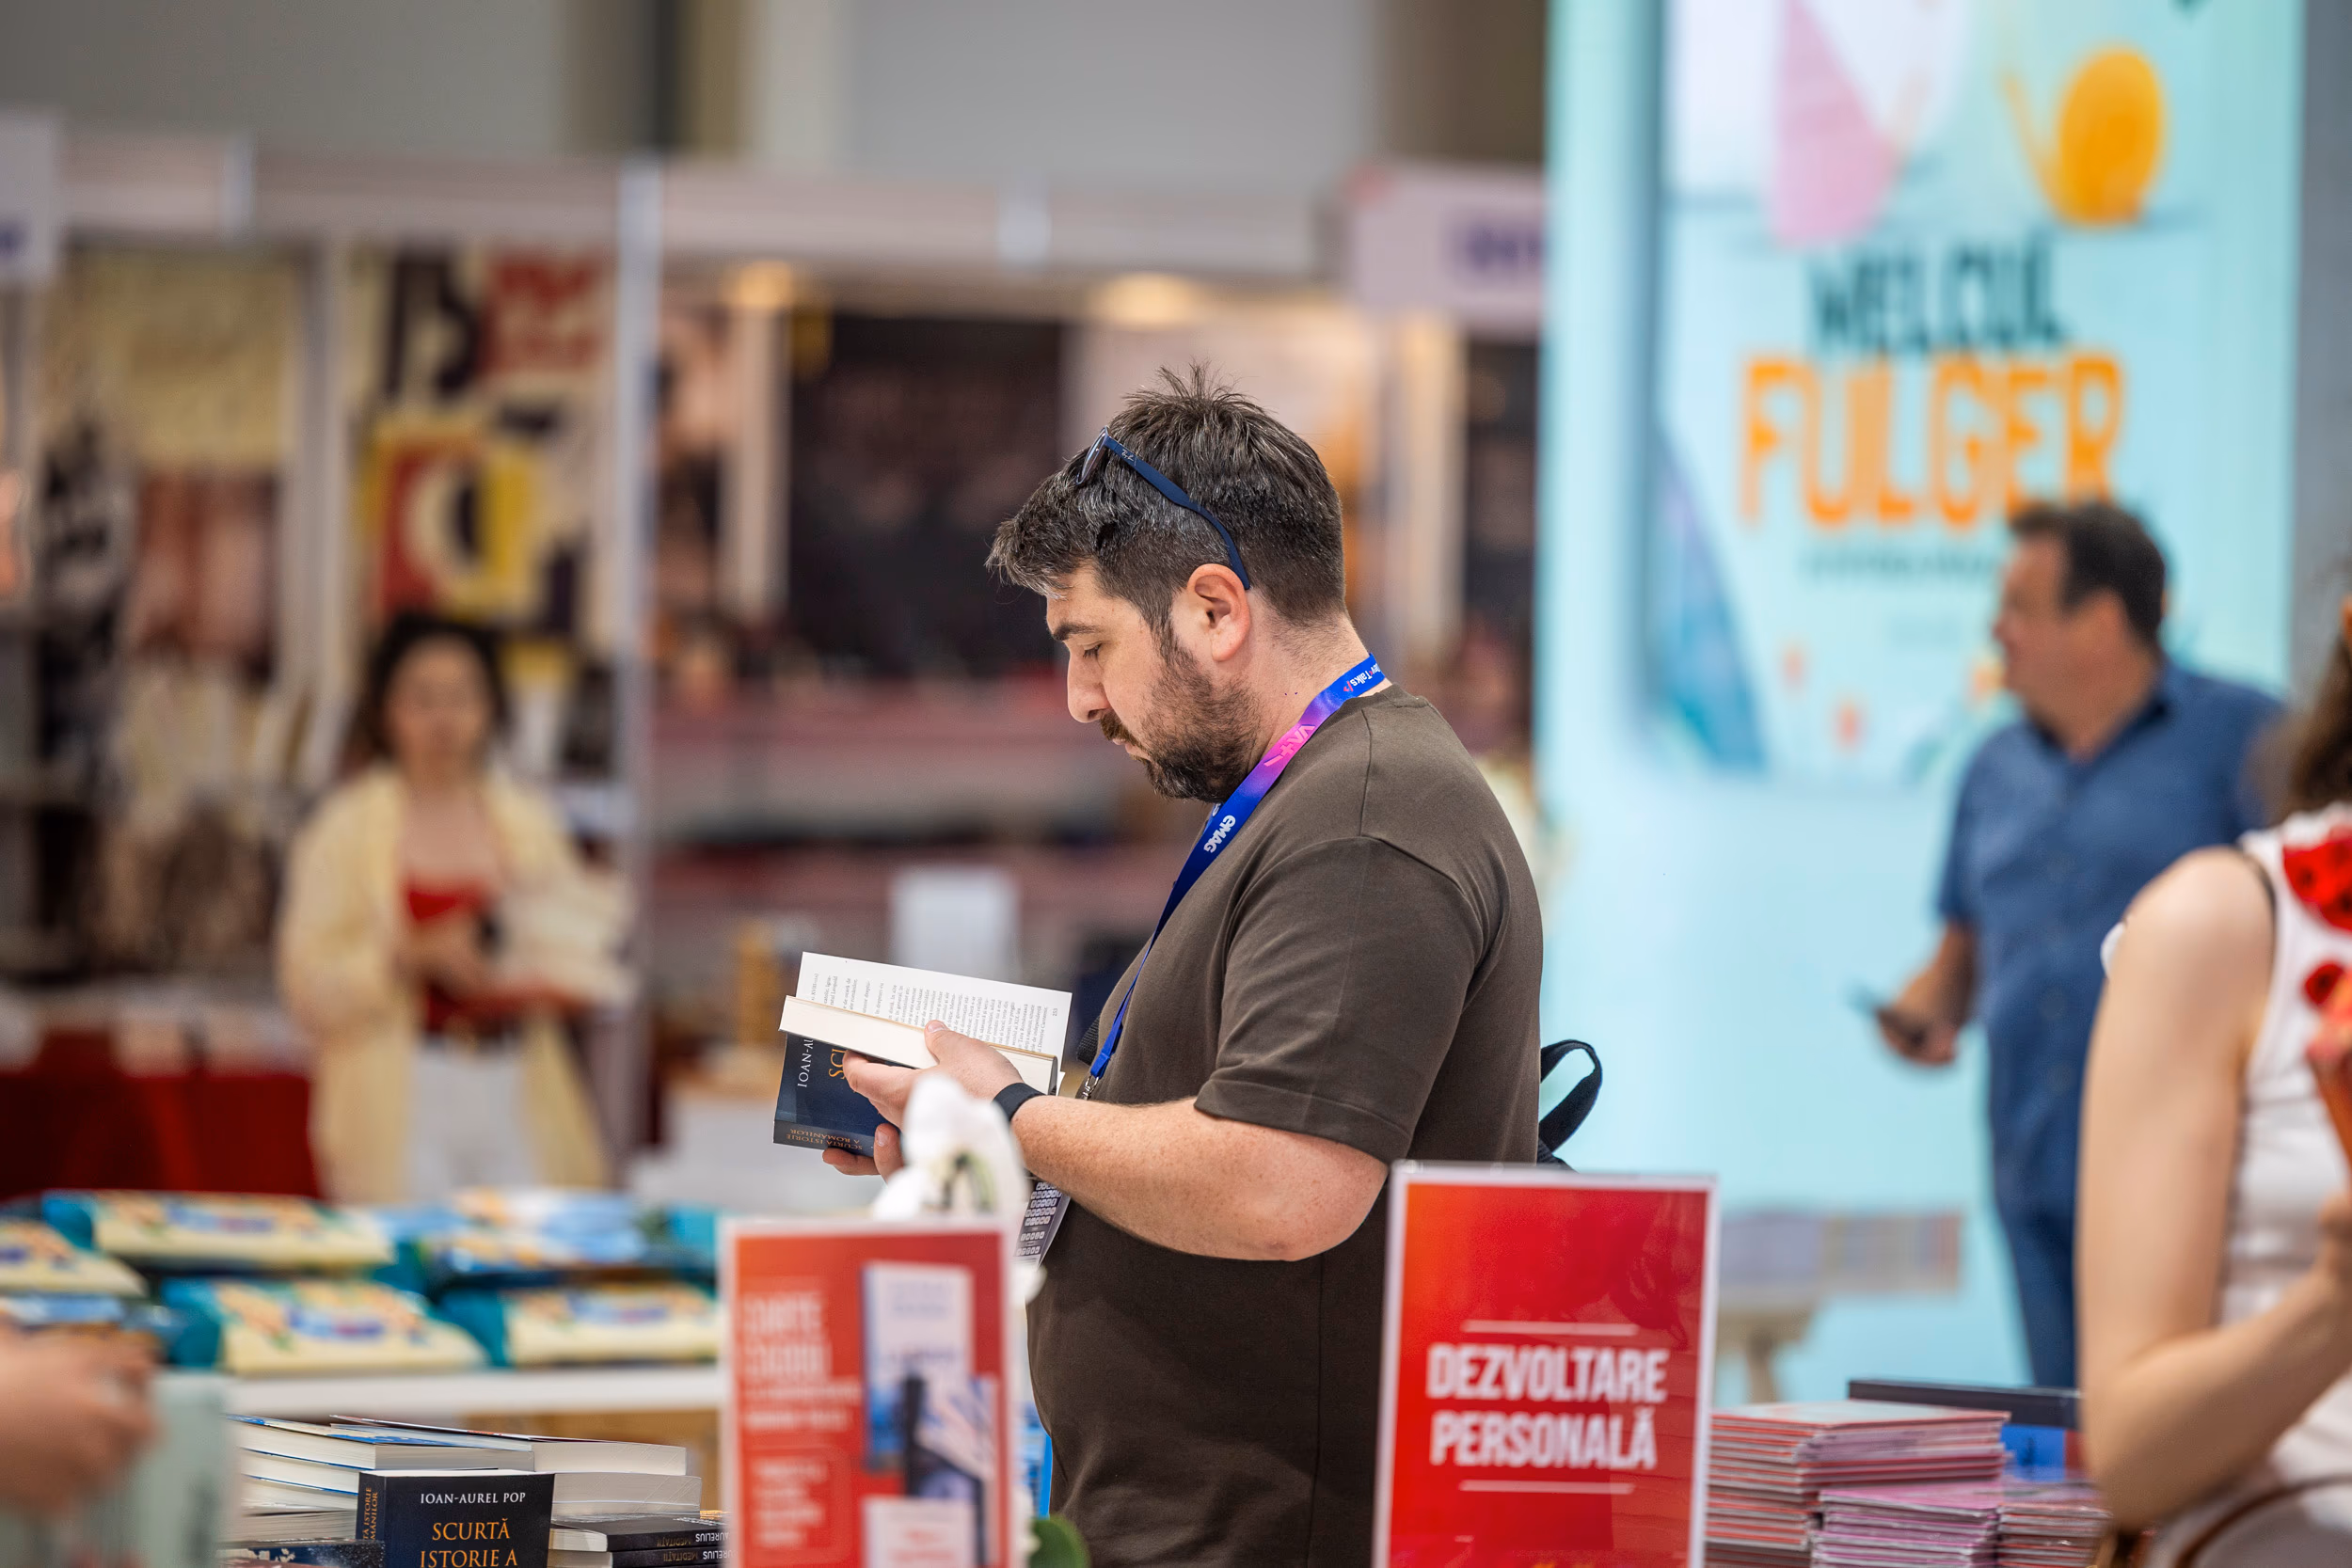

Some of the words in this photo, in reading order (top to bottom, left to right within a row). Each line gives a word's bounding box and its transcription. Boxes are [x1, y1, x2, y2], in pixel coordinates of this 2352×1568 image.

[1739, 352, 2124, 532] FULGER
[1203, 815, 1236, 853] eMAG
[786, 1133, 823, 1145] ISTORIE
[1425, 1342, 1670, 1403] DEZVOLTARE
[1429, 1406, 1658, 1470] PERSONALĂ
[364, 1487, 373, 1521] ISTORIE
[421, 1493, 499, 1504] IOAN-AUREL
[502, 1492, 526, 1503] POP
[432, 1517, 511, 1541] SCURTĂ
[420, 1549, 500, 1568] ISTORIE
[504, 1549, 518, 1566] A
[703, 1550, 735, 1560] URELIUS
